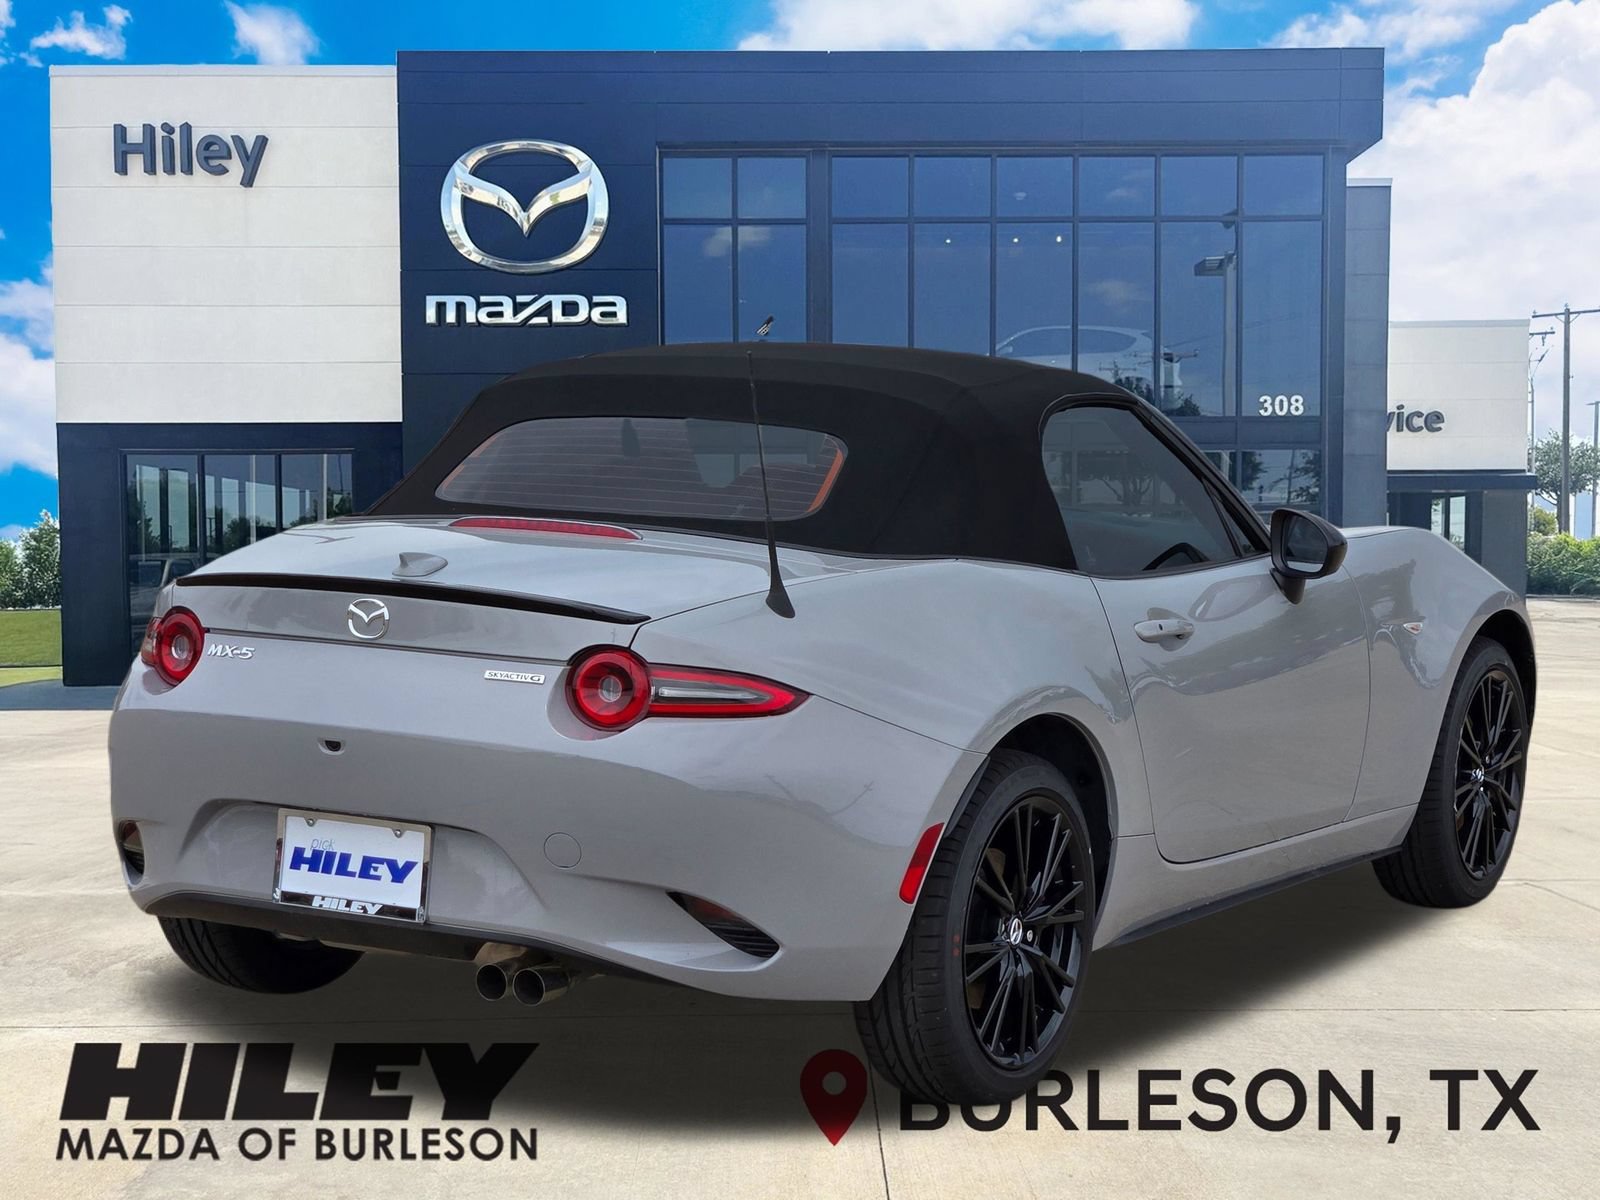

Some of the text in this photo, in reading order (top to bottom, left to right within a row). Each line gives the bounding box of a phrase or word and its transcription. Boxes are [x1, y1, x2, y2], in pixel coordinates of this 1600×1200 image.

[113, 123, 269, 187] Hiley
[1258, 395, 1305, 417] 308
[207, 643, 255, 661] MX-5
[310, 838, 336, 850] pick
[290, 847, 418, 884] HILEY
[312, 895, 383, 915] HILEY
